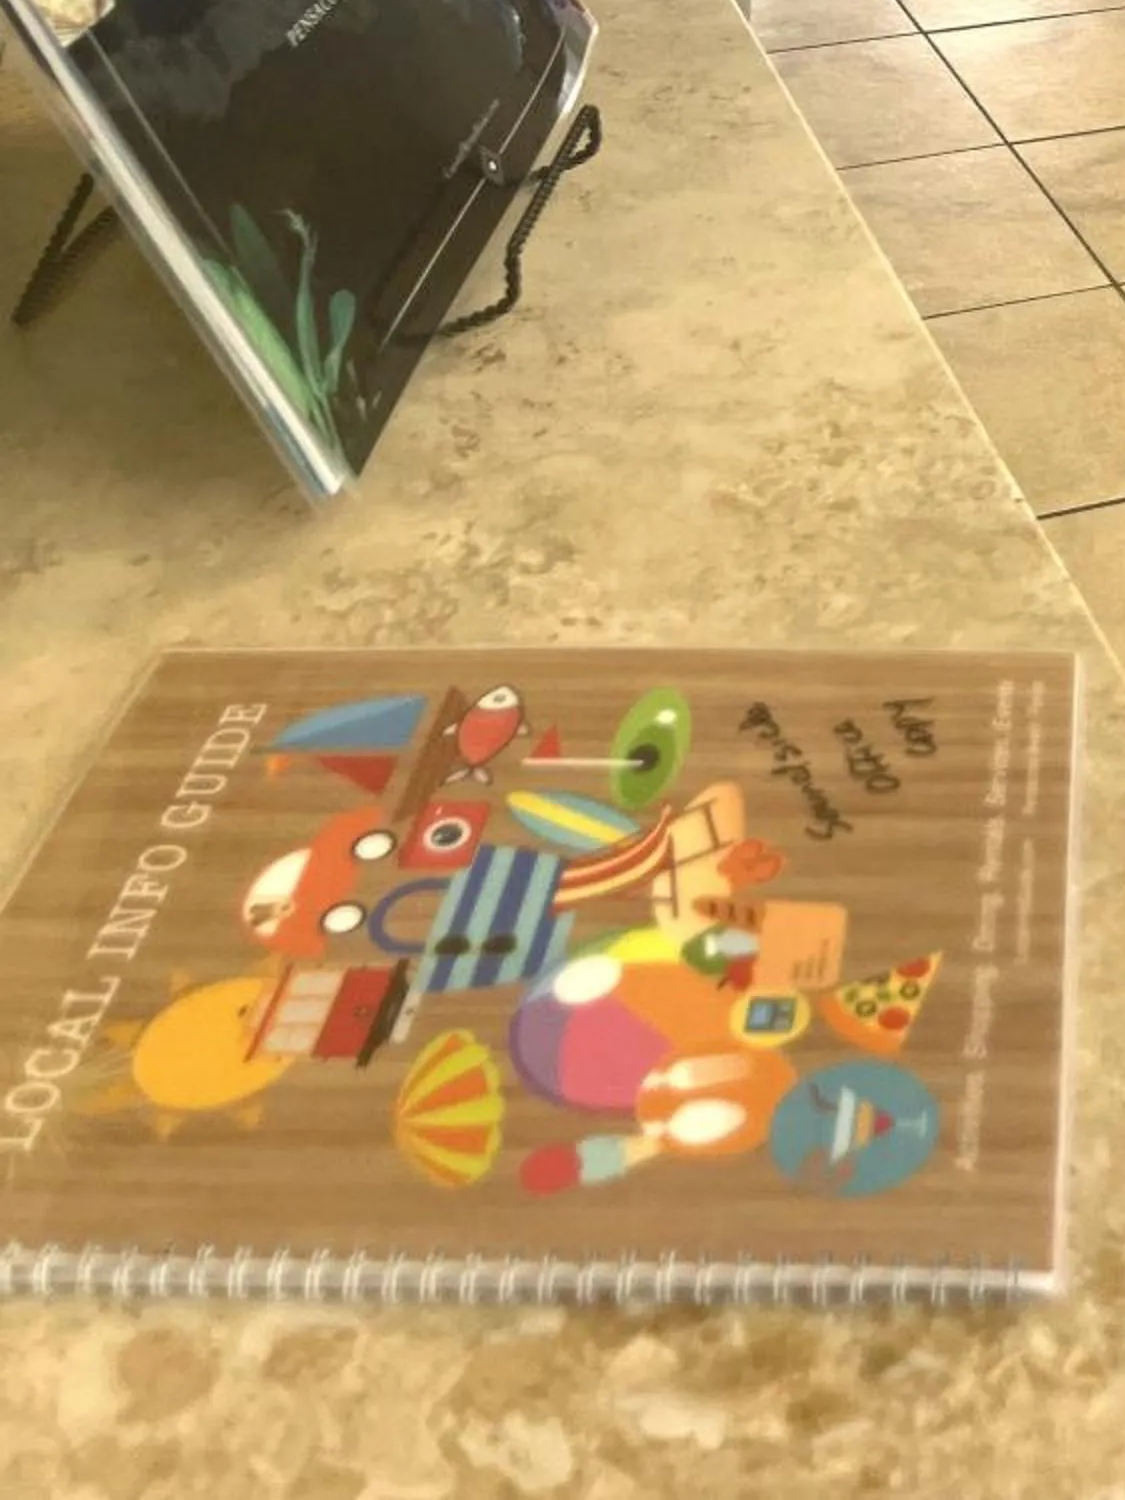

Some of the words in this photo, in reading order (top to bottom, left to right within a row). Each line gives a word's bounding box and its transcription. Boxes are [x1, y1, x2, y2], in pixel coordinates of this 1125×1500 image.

[0, 975, 121, 1153] LOCAL
[87, 843, 189, 962] INFO
[159, 701, 270, 832] GUIDE
